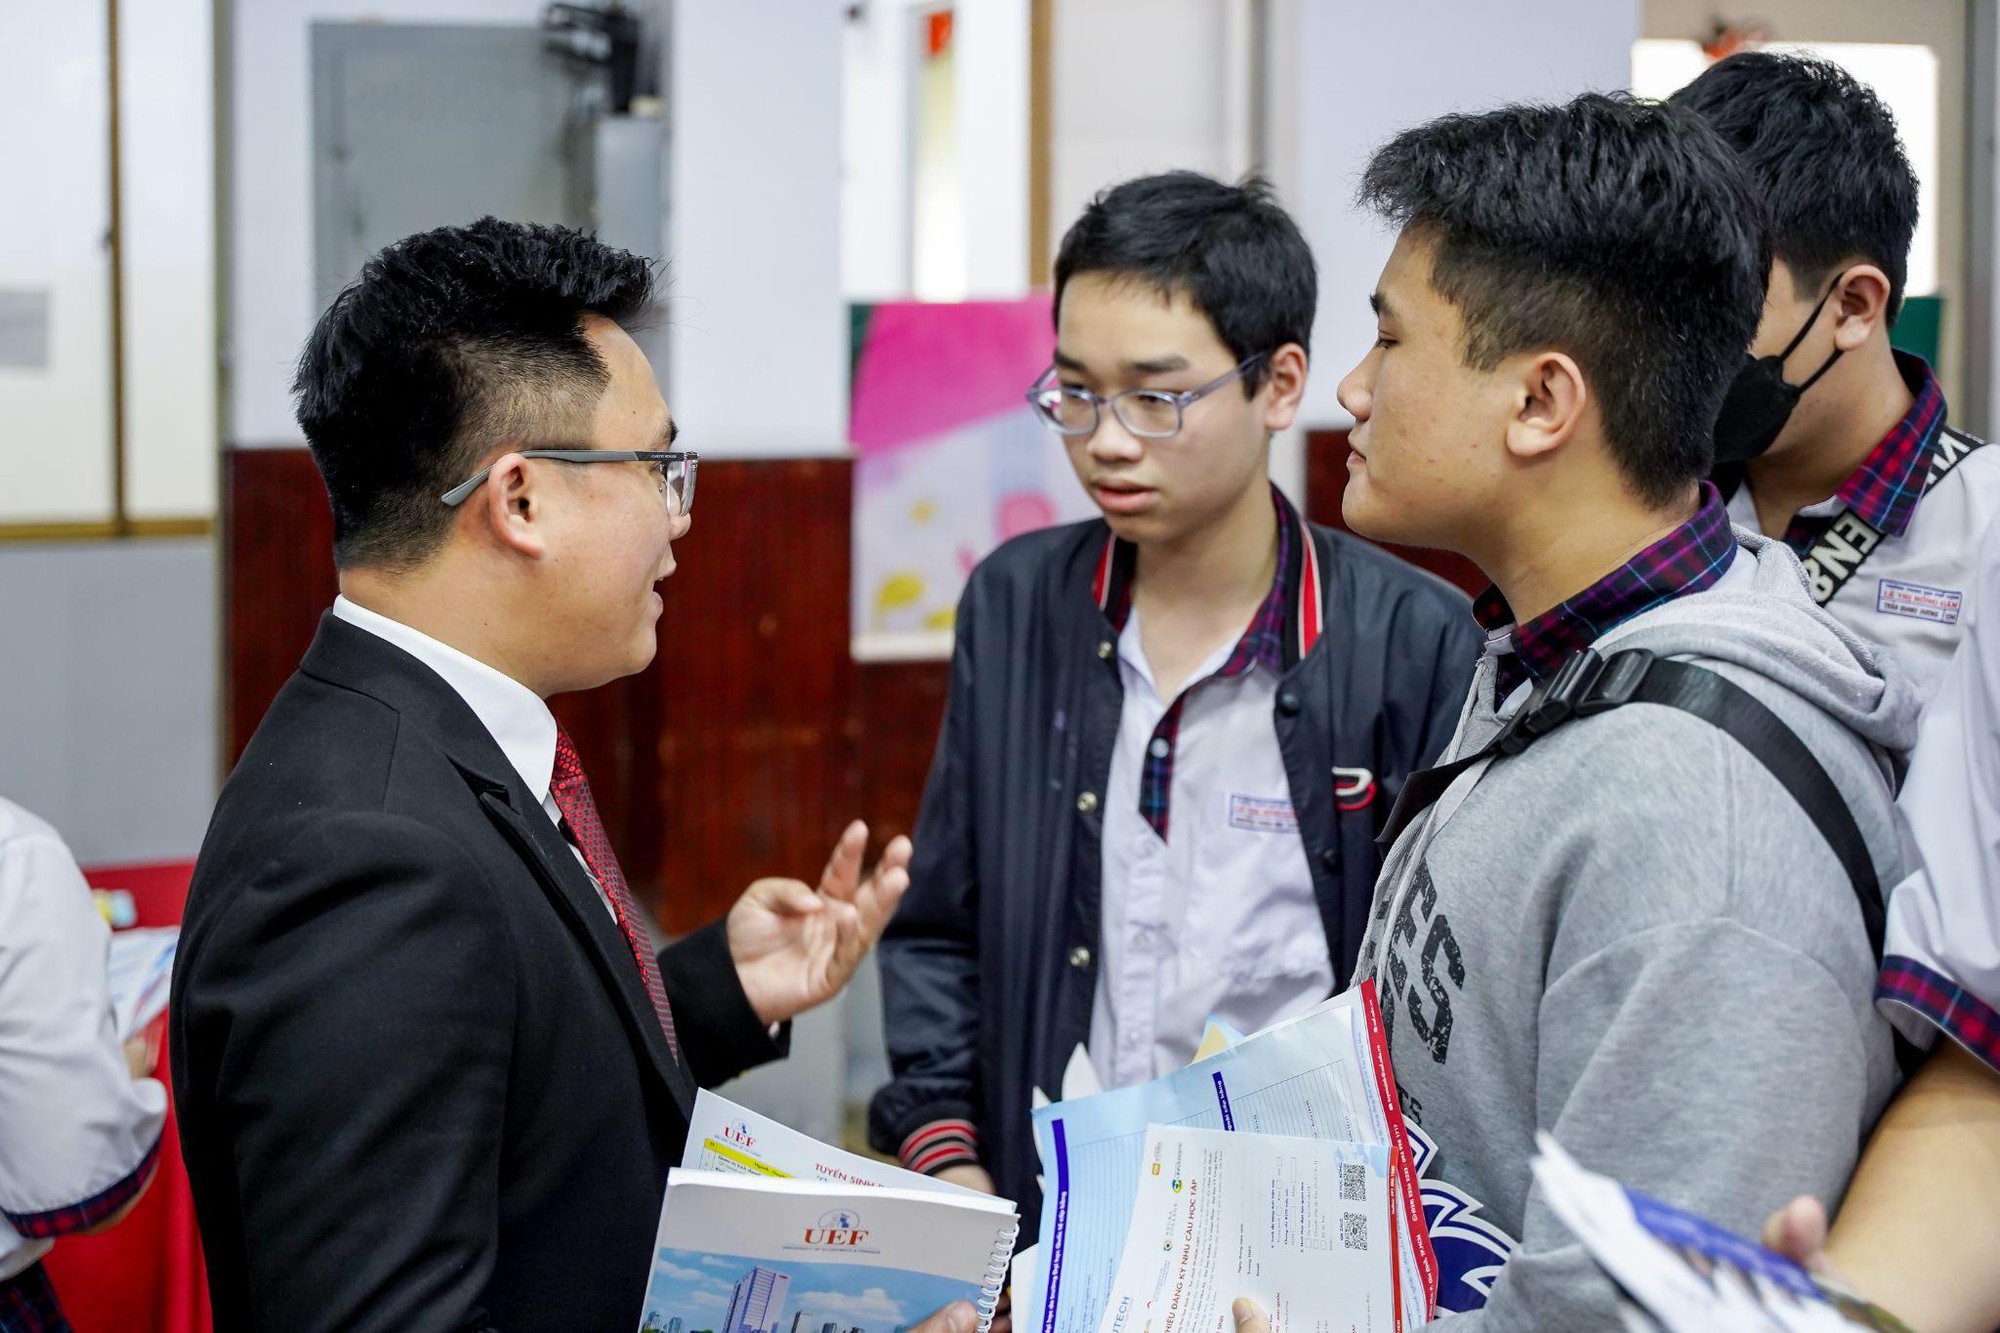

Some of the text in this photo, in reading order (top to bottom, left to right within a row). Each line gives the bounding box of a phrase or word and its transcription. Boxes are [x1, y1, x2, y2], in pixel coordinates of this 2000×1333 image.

[723, 1127, 756, 1147] UEF
[804, 1228, 868, 1246] UEF
[1162, 1310, 1176, 1333] HIẾU
